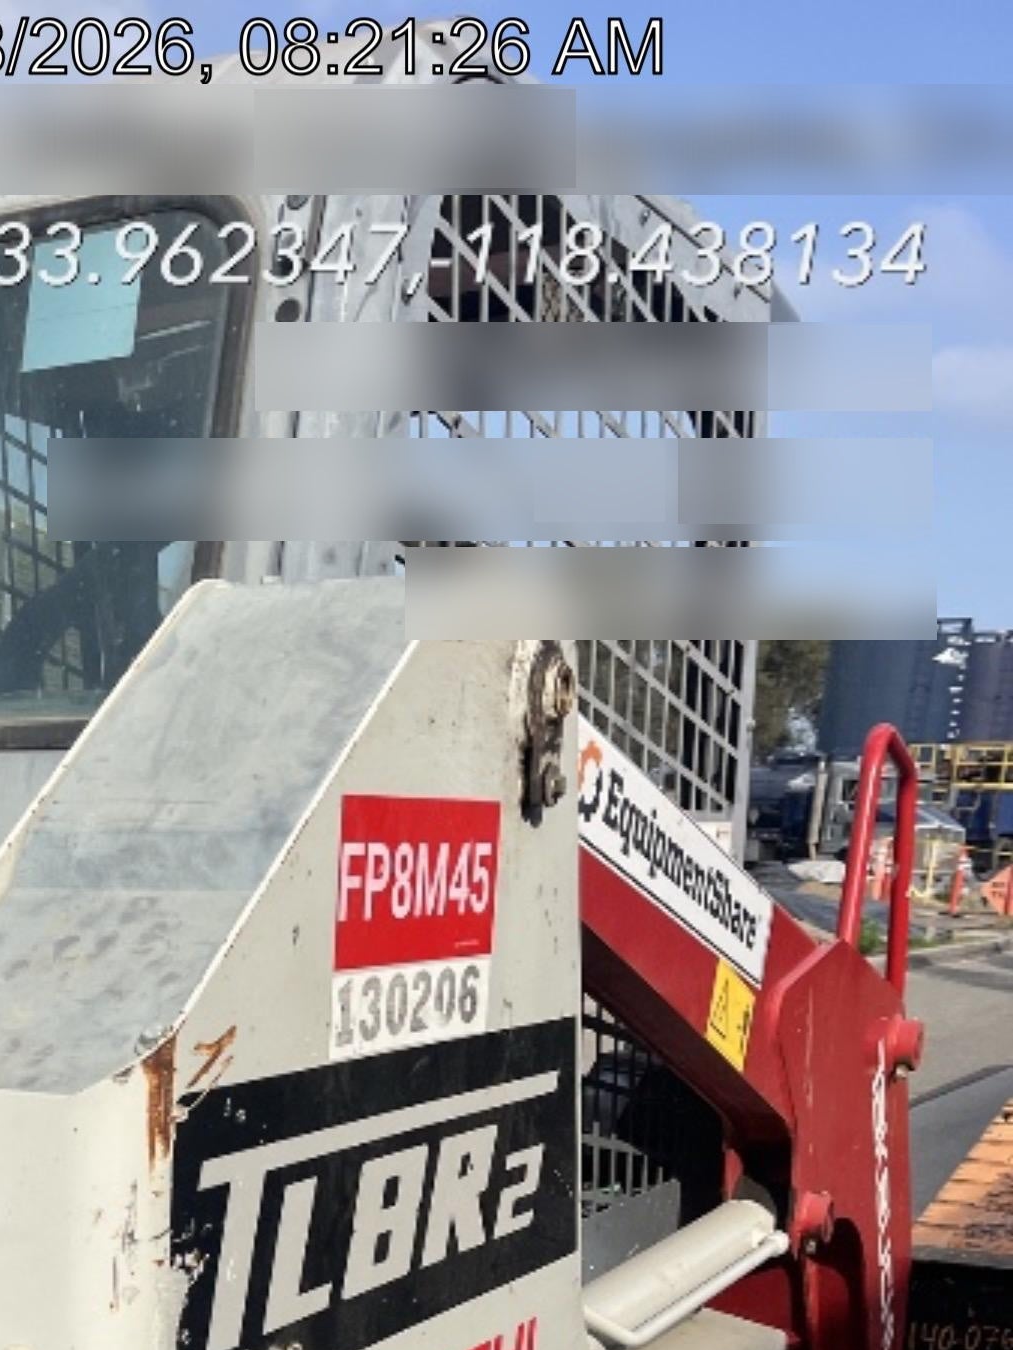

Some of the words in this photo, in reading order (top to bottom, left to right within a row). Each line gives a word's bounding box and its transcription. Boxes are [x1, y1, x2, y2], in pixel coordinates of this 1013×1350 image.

[338, 841, 492, 922] FP8M45
[602, 768, 757, 950] EquipmentShare
[335, 964, 480, 1048] 130206
